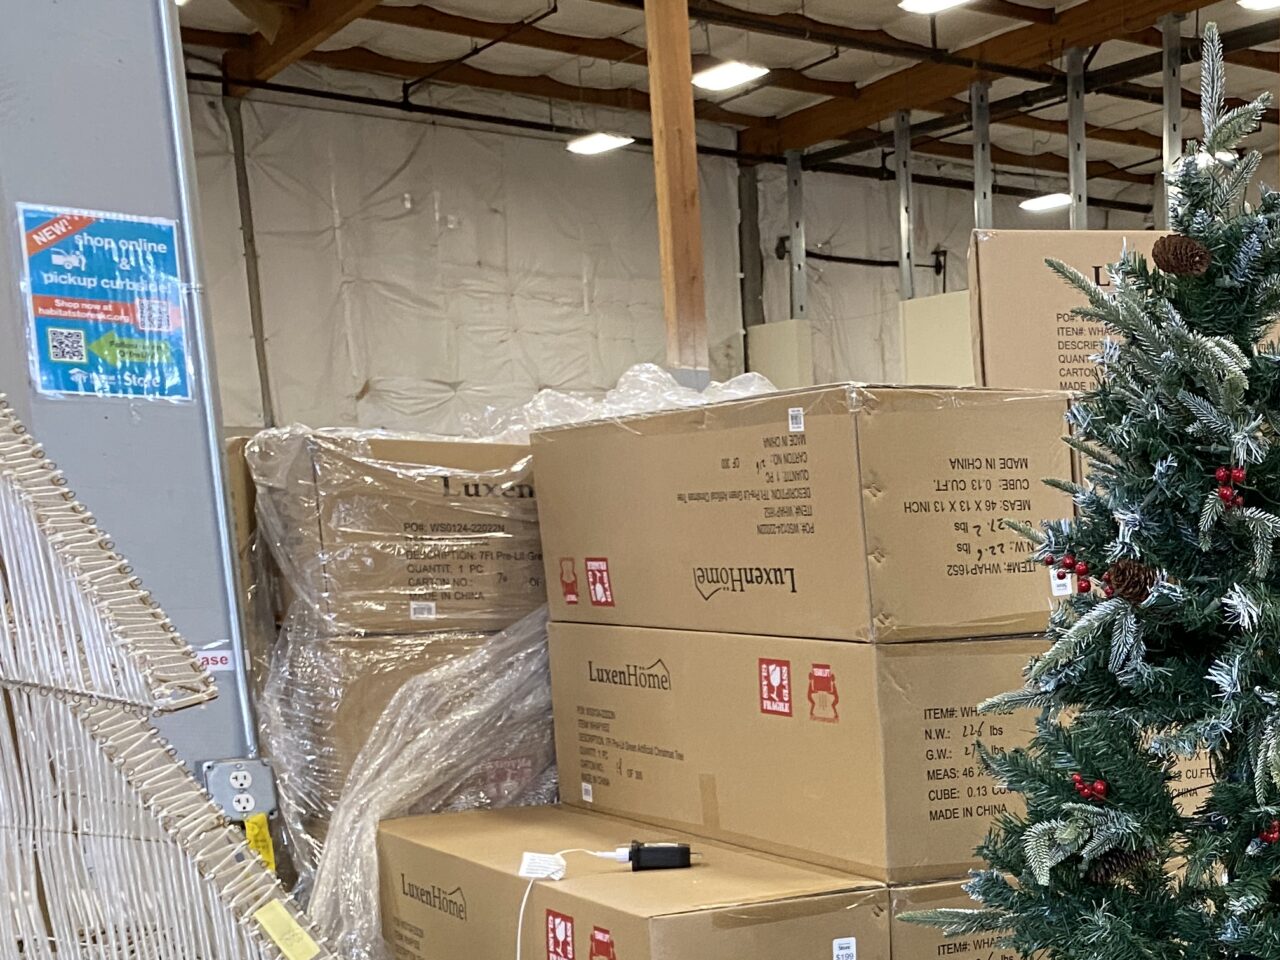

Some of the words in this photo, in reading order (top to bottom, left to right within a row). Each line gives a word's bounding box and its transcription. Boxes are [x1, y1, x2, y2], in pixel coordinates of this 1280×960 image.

[32, 218, 72, 246] NEW!
[74, 233, 117, 252] shop
[119, 239, 167, 253] online
[119, 257, 131, 270] &
[43, 272, 97, 289] pickup
[55, 299, 79, 308] Shop
[81, 301, 101, 309] now
[103, 303, 112, 311] at
[949, 458, 982, 470] CHINA
[986, 458, 996, 470] IN
[1000, 458, 1028, 470] MADE
[441, 476, 534, 498] Luxen
[971, 479, 992, 491] 0.13
[999, 478, 1029, 490] CUBE:
[904, 501, 931, 513] INCH
[934, 502, 945, 512] 13
[960, 501, 971, 511] 13
[986, 501, 997, 511] 46
[1000, 500, 1031, 511] MEAS:
[955, 522, 969, 533] lbs
[957, 543, 971, 553] lbs
[469, 565, 484, 573] PC
[947, 564, 1000, 576] WHAP1652
[454, 592, 485, 600] CHINA
[924, 708, 958, 720] ITEM#:
[990, 725, 1003, 736] lbs
[927, 768, 959, 781] MEAS:
[962, 768, 974, 778] 46
[928, 790, 960, 801] CUBE:
[967, 786, 988, 798] 0.13
[929, 808, 959, 821] MADE
[963, 807, 973, 818] IN
[976, 803, 1008, 817] CHINA
[937, 941, 971, 956] ITEM#:
[836, 953, 854, 960] $199
